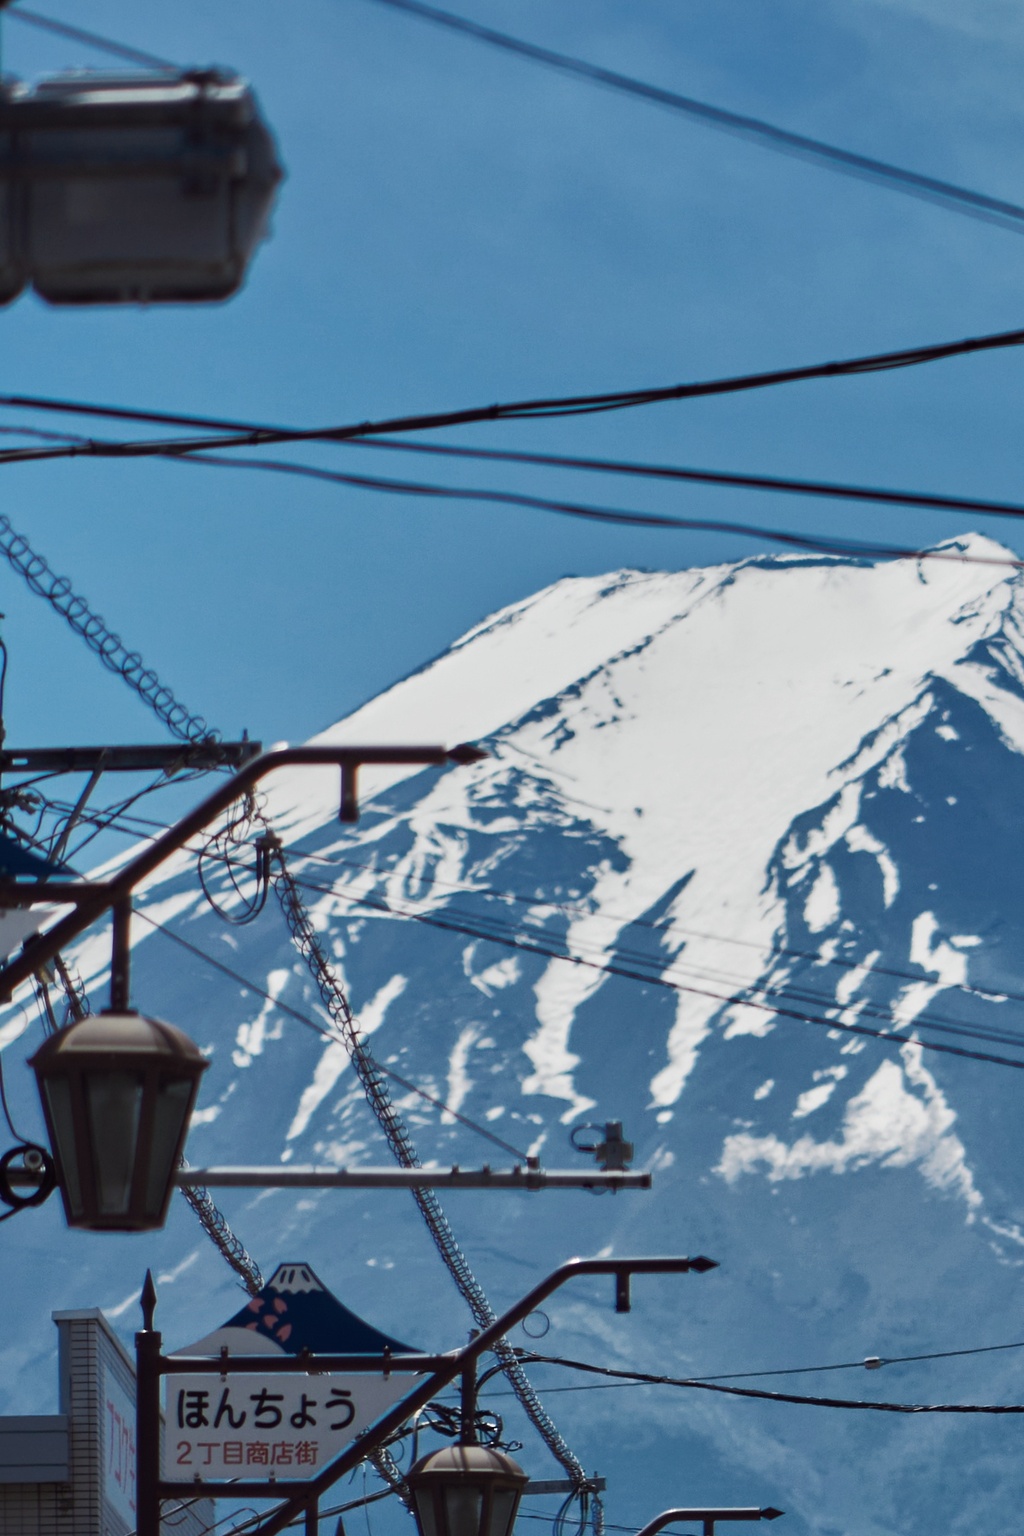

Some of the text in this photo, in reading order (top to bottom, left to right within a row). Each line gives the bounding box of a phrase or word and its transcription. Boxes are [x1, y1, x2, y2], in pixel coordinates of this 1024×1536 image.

[178, 1388, 355, 1430] ほんちょう
[177, 1441, 319, 1465] 2丁目商店街
